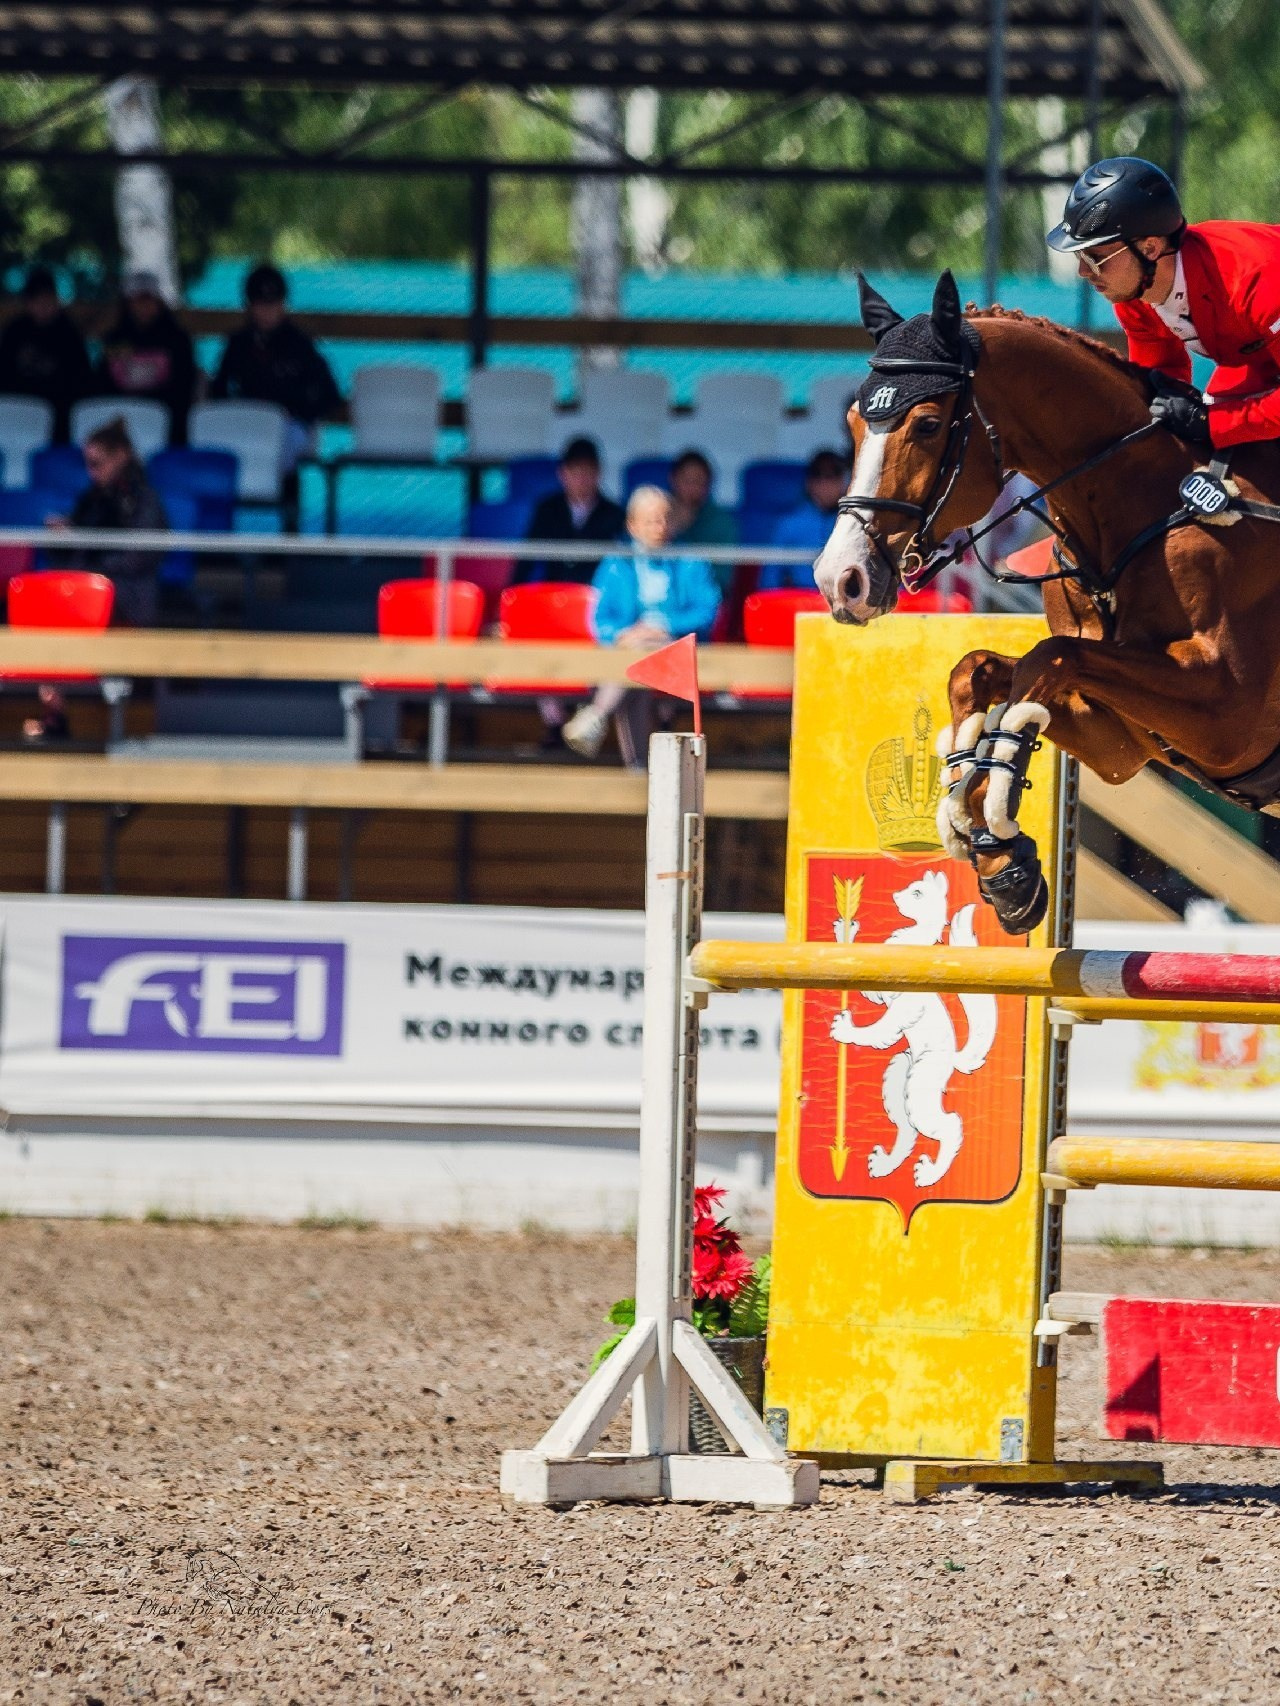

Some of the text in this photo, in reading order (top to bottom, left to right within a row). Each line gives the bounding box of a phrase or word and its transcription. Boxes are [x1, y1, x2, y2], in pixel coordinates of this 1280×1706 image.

[74, 950, 329, 1042] FEI
[404, 953, 645, 998] Междунар
[402, 1014, 592, 1046] конного
